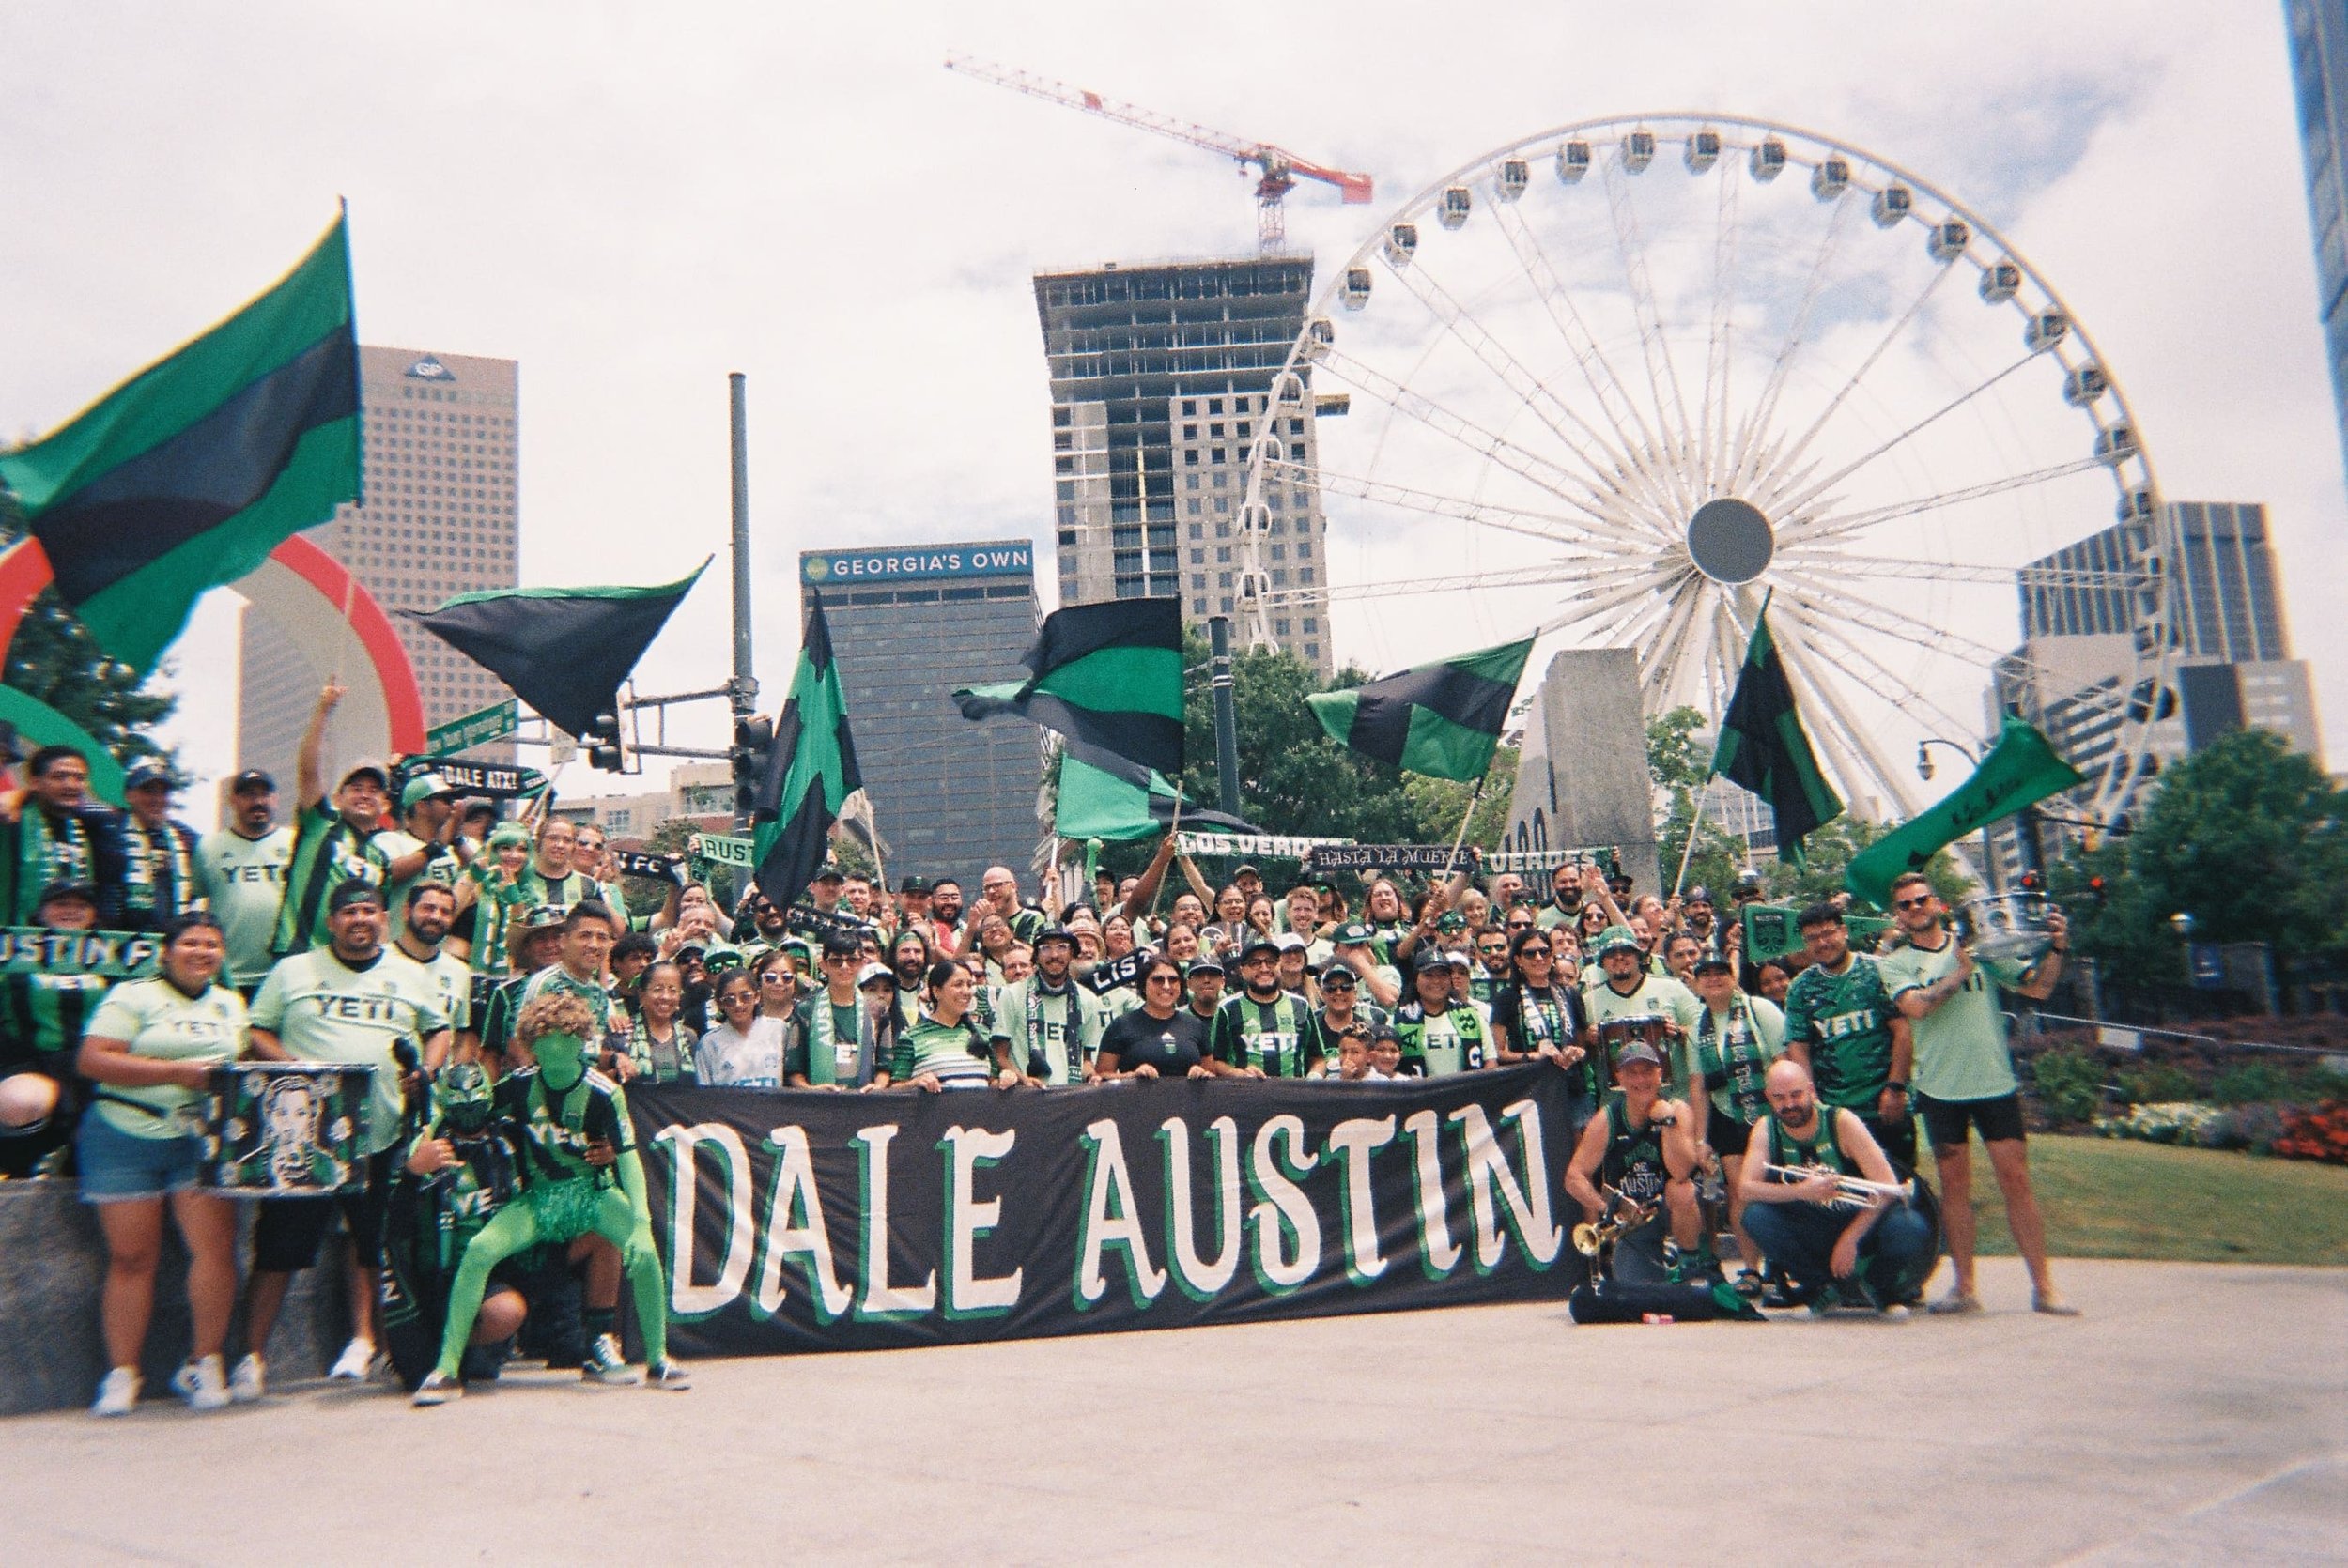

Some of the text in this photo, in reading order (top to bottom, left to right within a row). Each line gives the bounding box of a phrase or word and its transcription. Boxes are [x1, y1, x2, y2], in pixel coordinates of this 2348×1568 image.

[414, 362, 444, 377] GP
[833, 550, 1027, 576] GEORGIA'S OWN
[487, 770, 517, 789] ATX!
[1177, 833, 1232, 854] LOS
[634, 855, 662, 873] FC
[1317, 849, 1372, 867] HASTA
[315, 994, 394, 1021] YETI
[1812, 1008, 1875, 1038] YETI
[1240, 1032, 1300, 1052] YETI
[652, 1098, 1563, 1323] DALE AUSTIN
